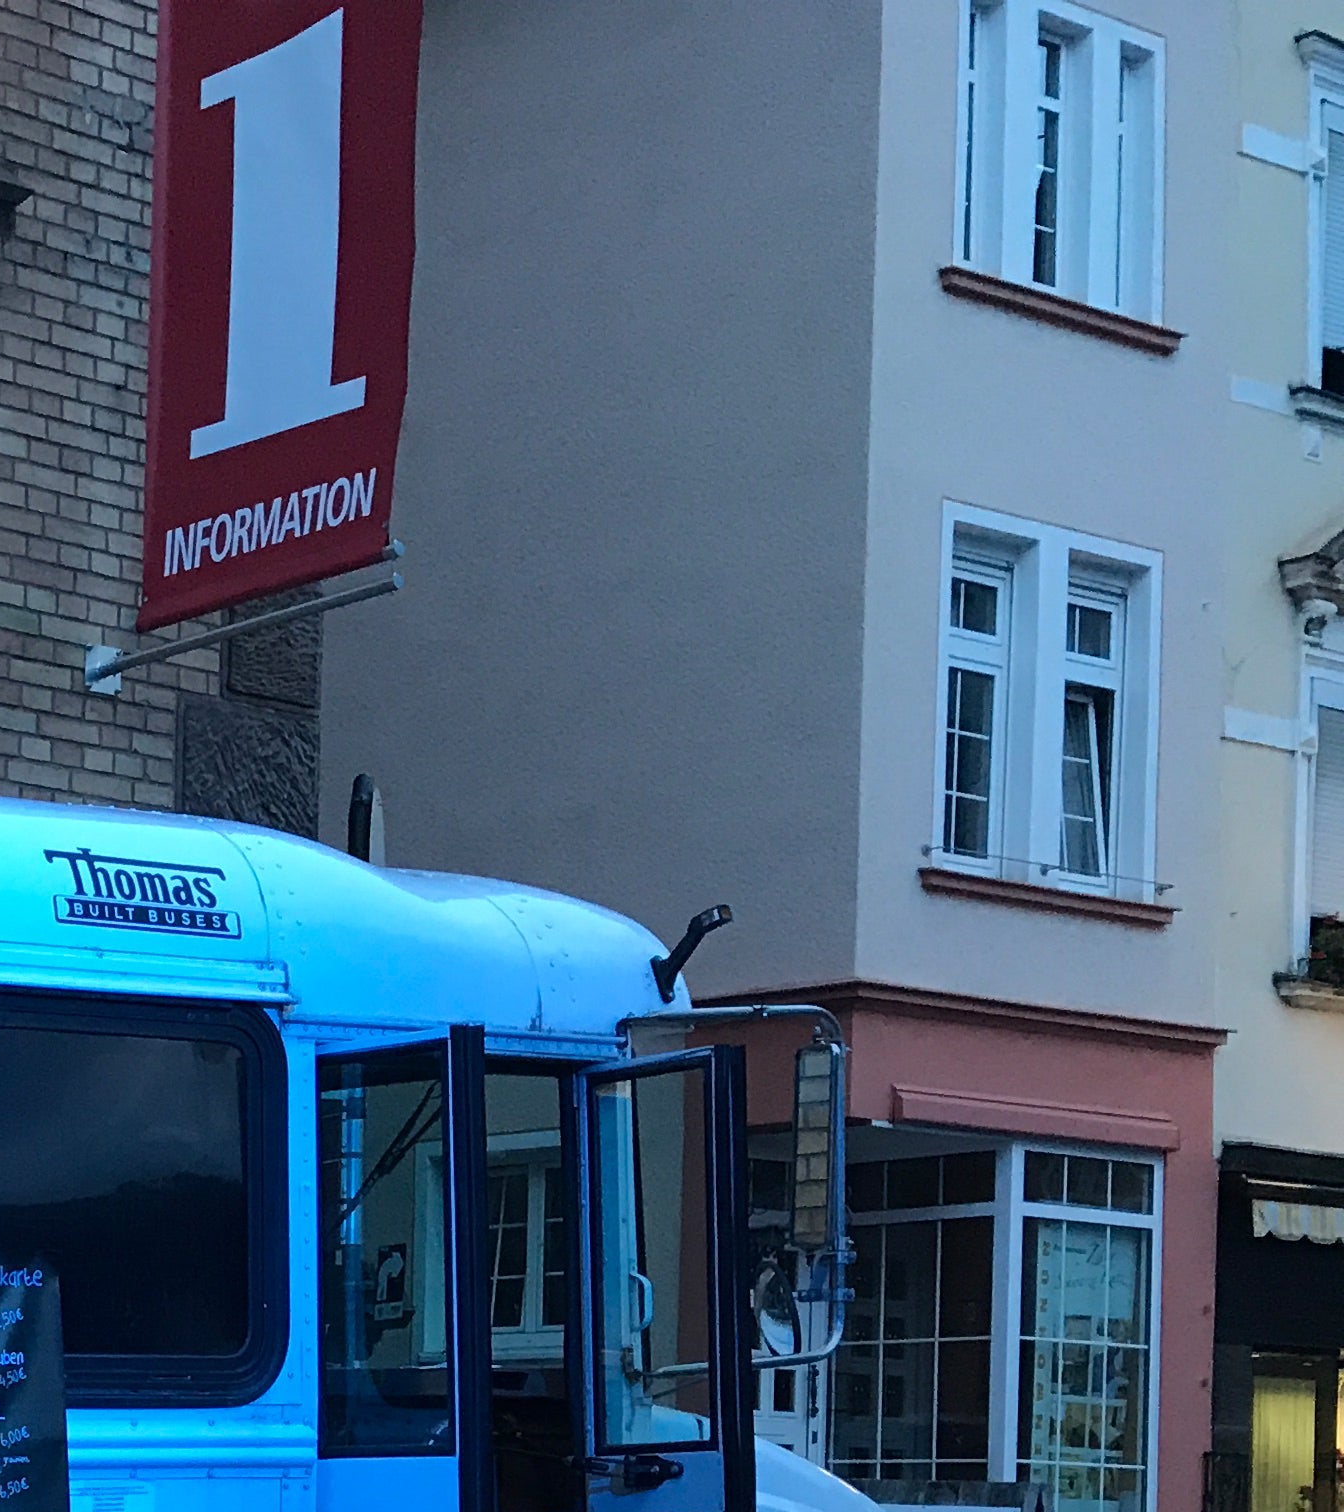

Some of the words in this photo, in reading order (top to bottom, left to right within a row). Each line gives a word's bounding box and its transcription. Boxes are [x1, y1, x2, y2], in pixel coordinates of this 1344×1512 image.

[189, 7, 366, 459] 1
[163, 467, 377, 577] INFORMATION
[43, 847, 226, 909] Thomas
[73, 902, 136, 921] BUILT
[148, 909, 221, 929] BUSES
[0, 1426, 31, 1449] 6,00€
[0, 1477, 30, 1499] 6,50€
